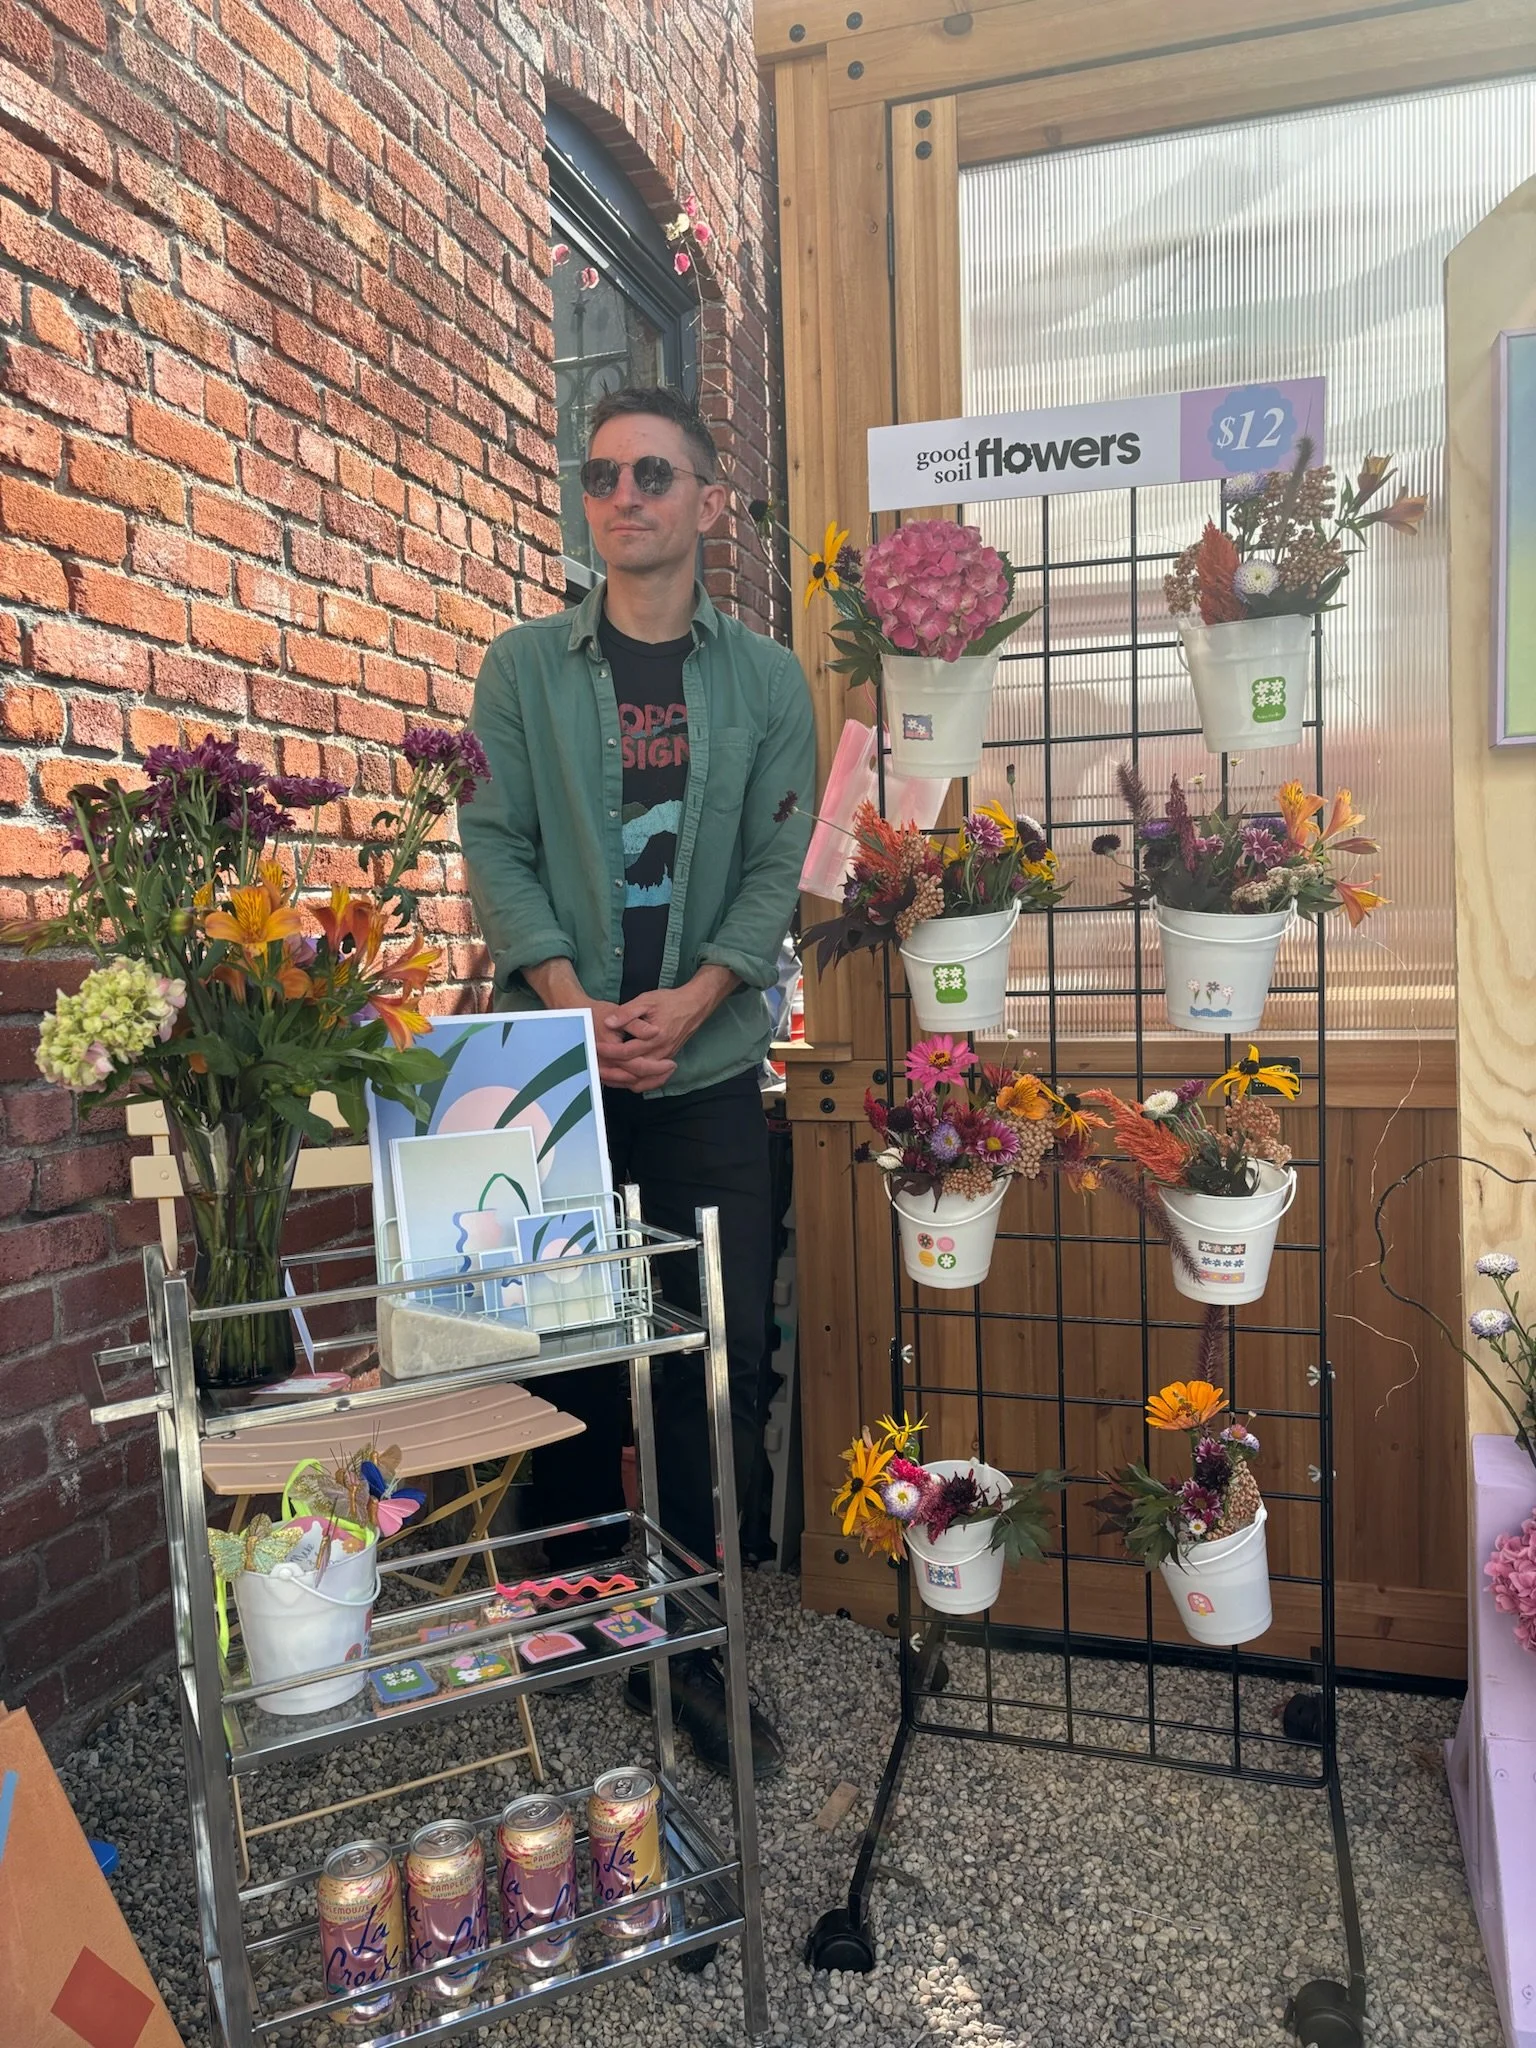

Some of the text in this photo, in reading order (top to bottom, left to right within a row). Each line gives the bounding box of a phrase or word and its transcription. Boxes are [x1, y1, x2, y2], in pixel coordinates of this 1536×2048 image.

[1216, 407, 1285, 451] $12
[916, 440, 971, 471] good
[934, 461, 972, 484] soil
[975, 432, 1141, 479] flowers
[603, 1830, 638, 1877] La
[352, 1903, 390, 1956] La
[326, 1944, 399, 1995] Croix
